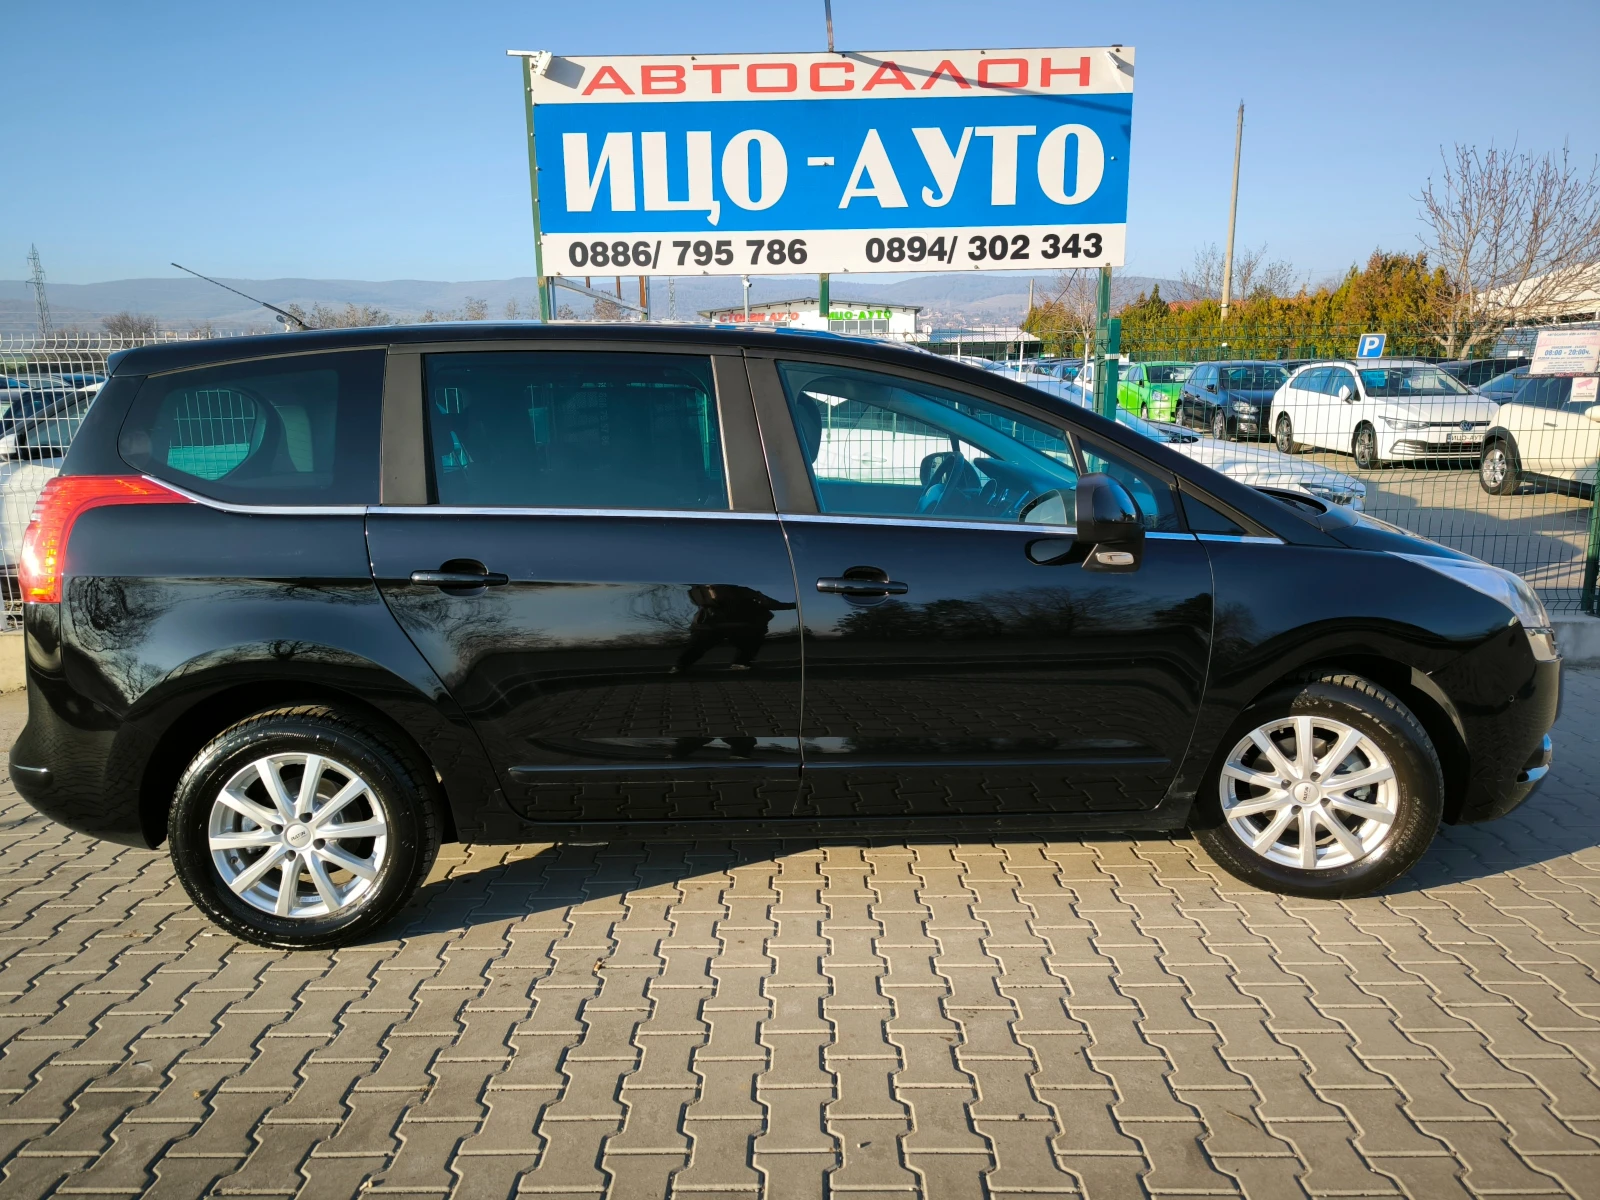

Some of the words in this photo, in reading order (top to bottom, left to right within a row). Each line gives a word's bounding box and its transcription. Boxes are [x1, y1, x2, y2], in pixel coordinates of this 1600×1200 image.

[582, 56, 1091, 96] АВТОСАЛОН
[568, 241, 662, 269] 0886/
[672, 240, 734, 266] 795
[746, 239, 808, 265] 786
[865, 236, 958, 264] 0894/
[967, 235, 1030, 261] 302
[1041, 233, 1103, 260] 343
[1362, 337, 1380, 356] P
